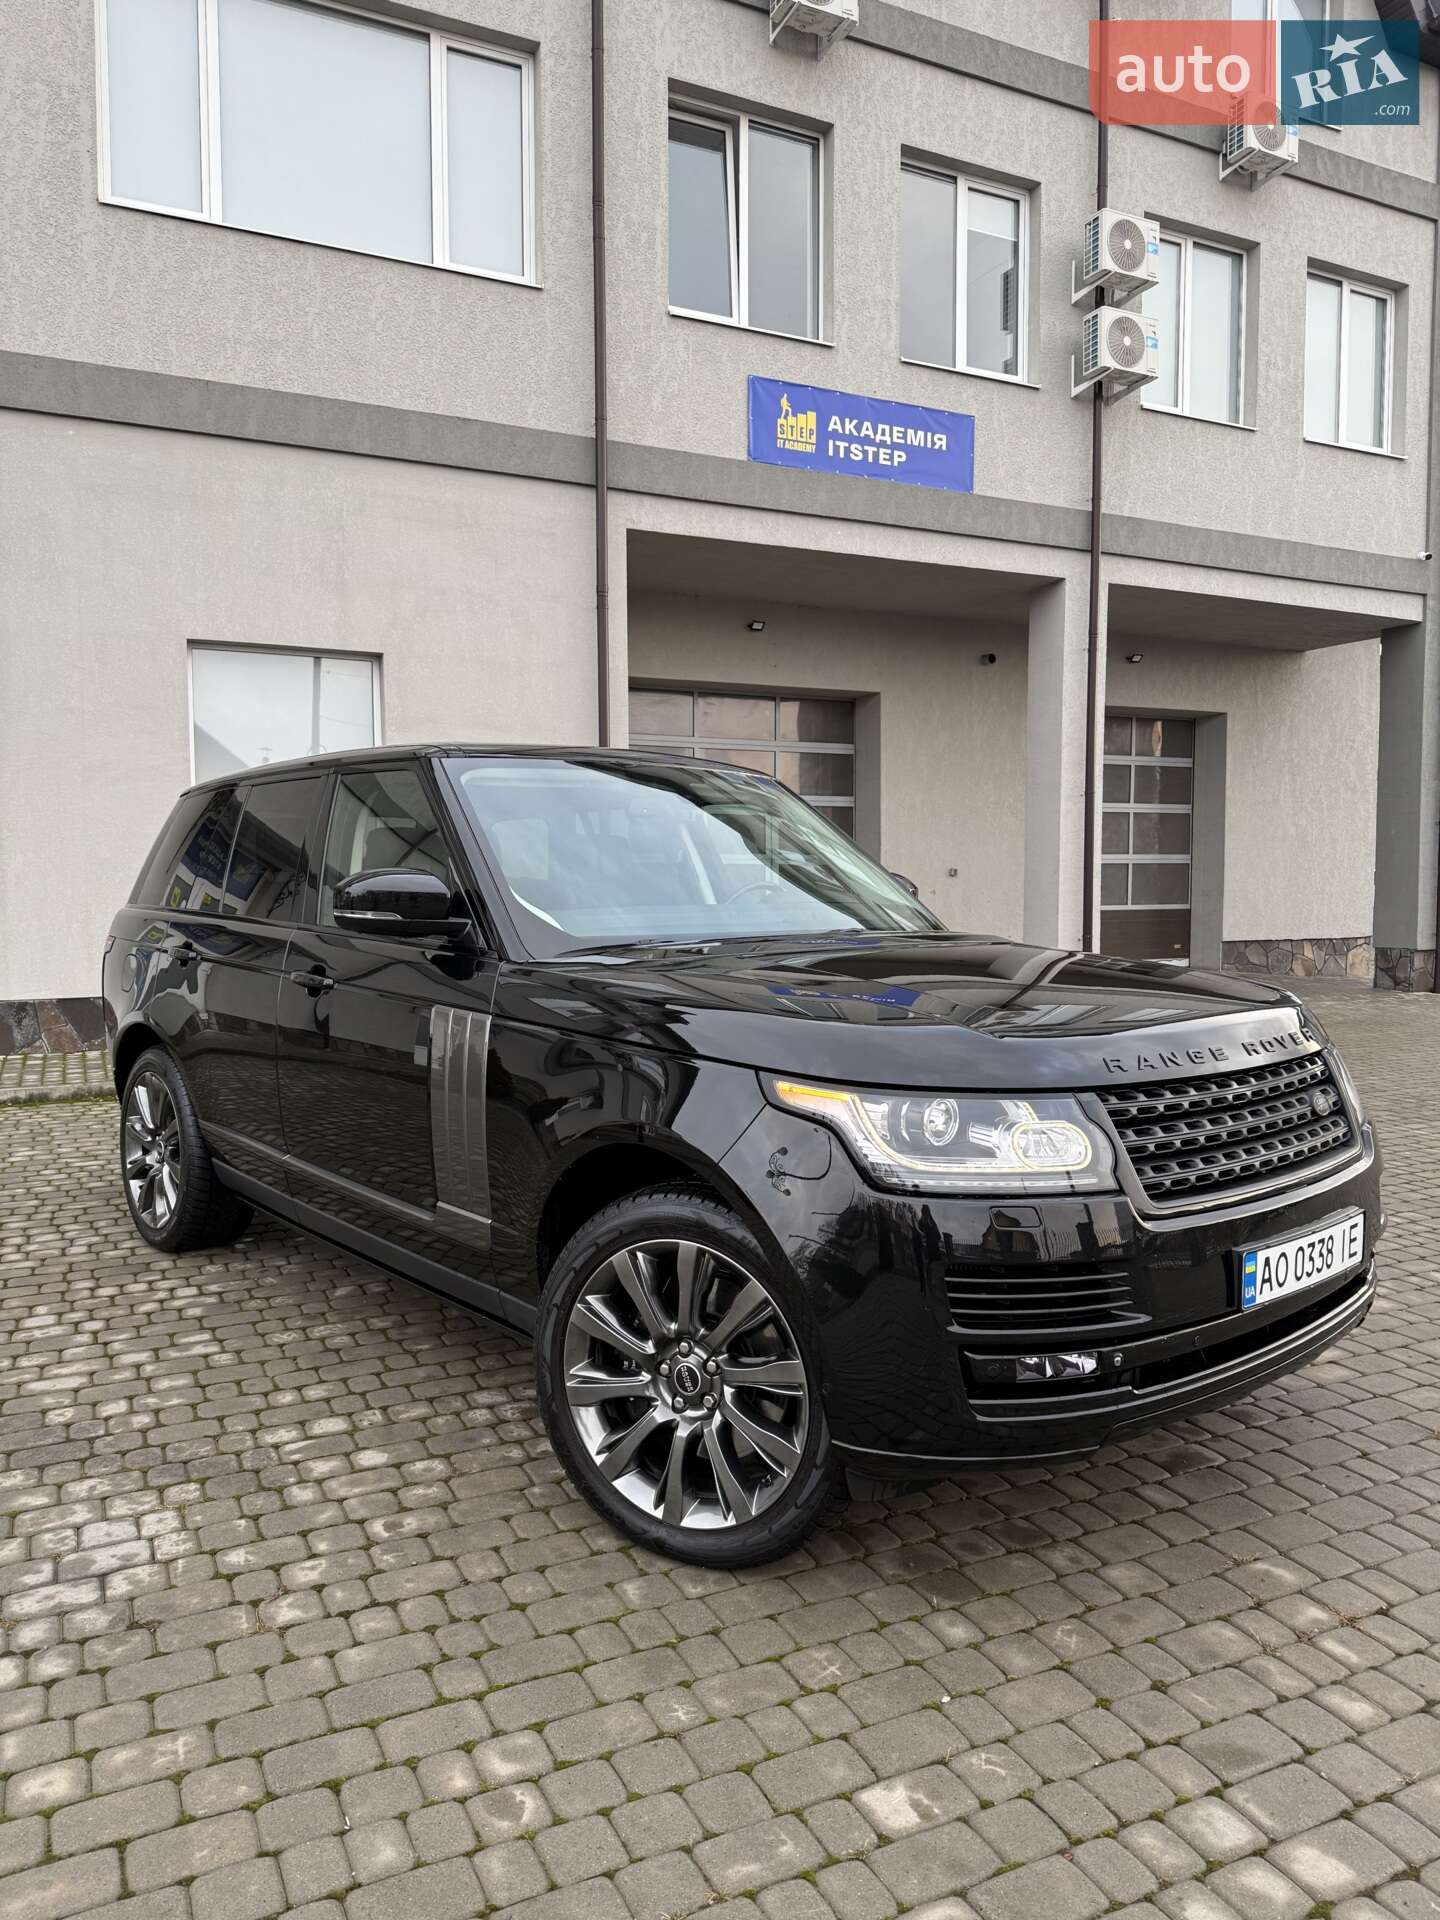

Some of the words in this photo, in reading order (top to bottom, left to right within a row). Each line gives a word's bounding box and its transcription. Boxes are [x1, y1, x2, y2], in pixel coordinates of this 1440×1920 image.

[779, 423, 815, 441] STEP
[828, 415, 948, 451] АКАДЕМІЯ
[828, 439, 907, 467] ITSTEP
[1102, 1046, 1229, 1074] RANGE
[1241, 1027, 1316, 1057] ROVER
[1259, 1251, 1289, 1295] AO
[1294, 1234, 1335, 1282] 0338
[1341, 1222, 1360, 1263] IE
[1245, 1286, 1256, 1299] UA
